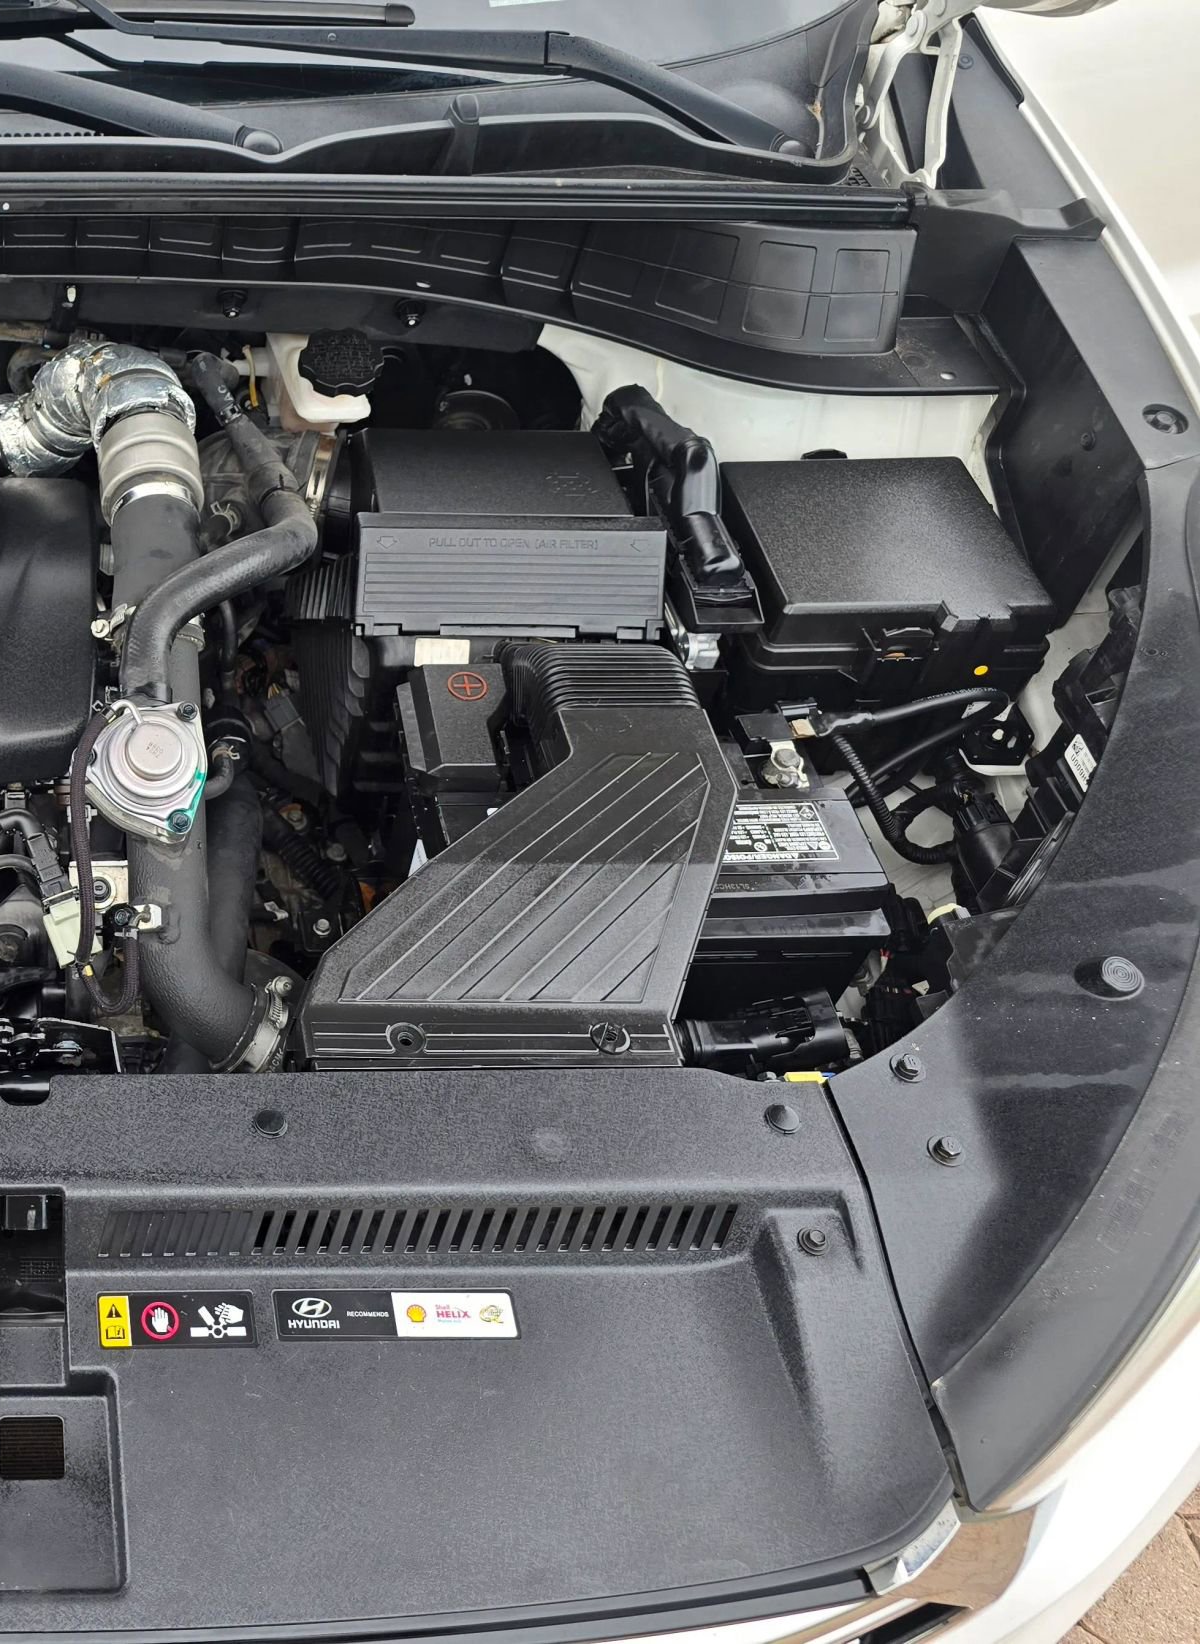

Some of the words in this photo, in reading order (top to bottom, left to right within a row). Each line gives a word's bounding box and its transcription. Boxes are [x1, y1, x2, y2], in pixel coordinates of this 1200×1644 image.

[428, 537, 456, 548] PULL
[458, 537, 482, 548] OUT
[483, 537, 498, 548] TO
[500, 538, 530, 549] OPEN
[346, 1310, 389, 1318] RECOMMENDS
[436, 1310, 472, 1319] HELIX
[287, 1319, 340, 1329] HYUNDAI
